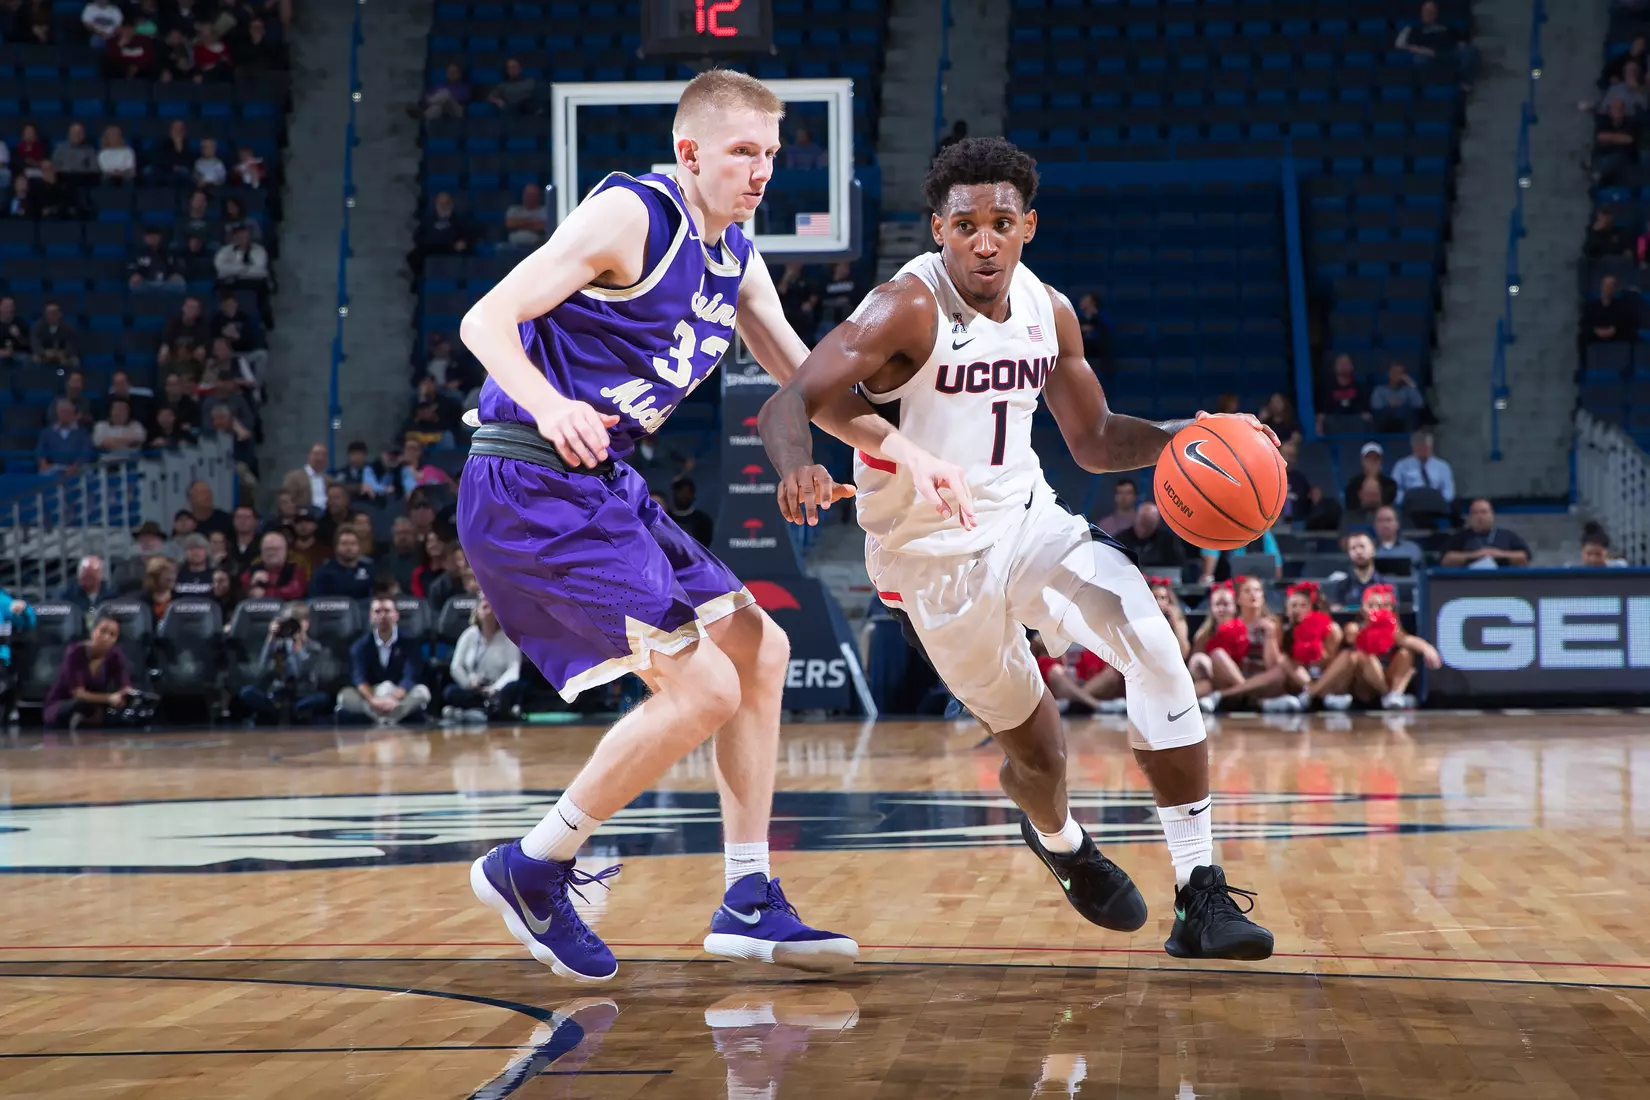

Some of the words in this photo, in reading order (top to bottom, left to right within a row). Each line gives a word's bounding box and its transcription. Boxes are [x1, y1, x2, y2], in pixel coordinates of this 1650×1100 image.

[695, 0, 741, 37] 12
[726, 372, 779, 387] SPALDIN
[935, 355, 1056, 394] UCONN
[729, 435, 764, 446] TRAVEL
[990, 400, 1008, 467] 1
[728, 483, 776, 494] TRAVELERS
[1163, 480, 1194, 518] UCONN
[728, 538, 777, 548] TRAVELERS
